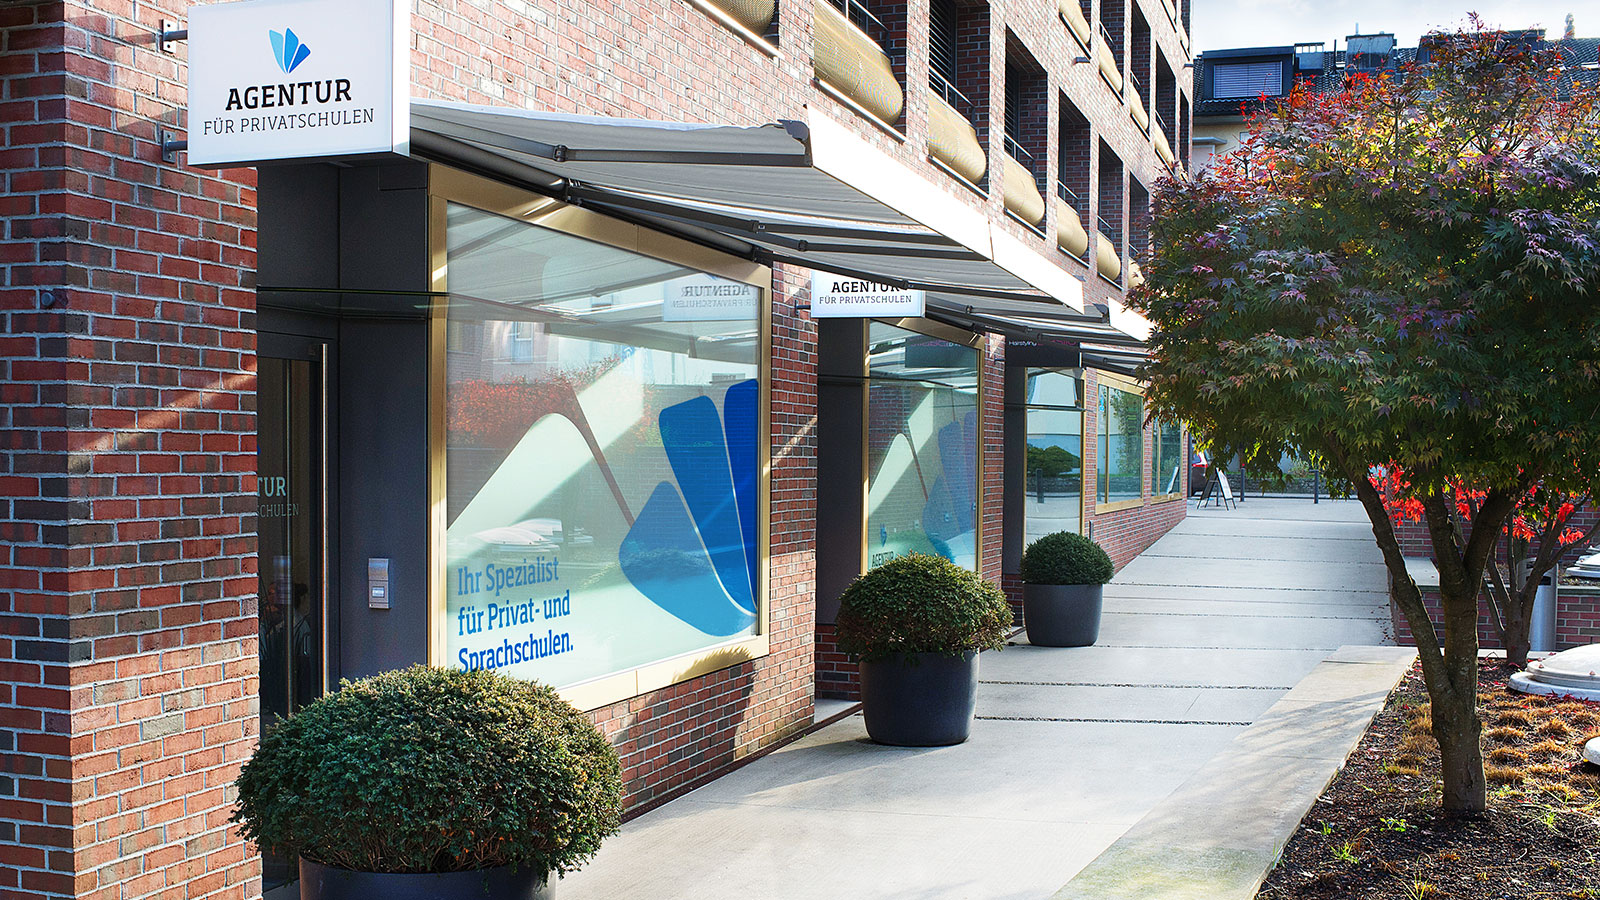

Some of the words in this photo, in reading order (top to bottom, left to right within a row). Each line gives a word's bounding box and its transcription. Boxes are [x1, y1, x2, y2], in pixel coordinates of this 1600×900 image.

[225, 78, 351, 111] AGENTUR
[203, 117, 235, 135] FÜR
[240, 108, 374, 132] PRIVATSCHULEN
[819, 295, 837, 305] FÜR
[839, 294, 912, 304] PRIVATSCHULEN
[257, 503, 299, 518] CHULEN
[457, 566, 482, 595] Ihr
[486, 556, 559, 596] Spezialist
[457, 606, 484, 636] für
[487, 598, 540, 630] Privat-
[543, 589, 571, 619] und
[458, 629, 574, 674] Sprachschulen.
